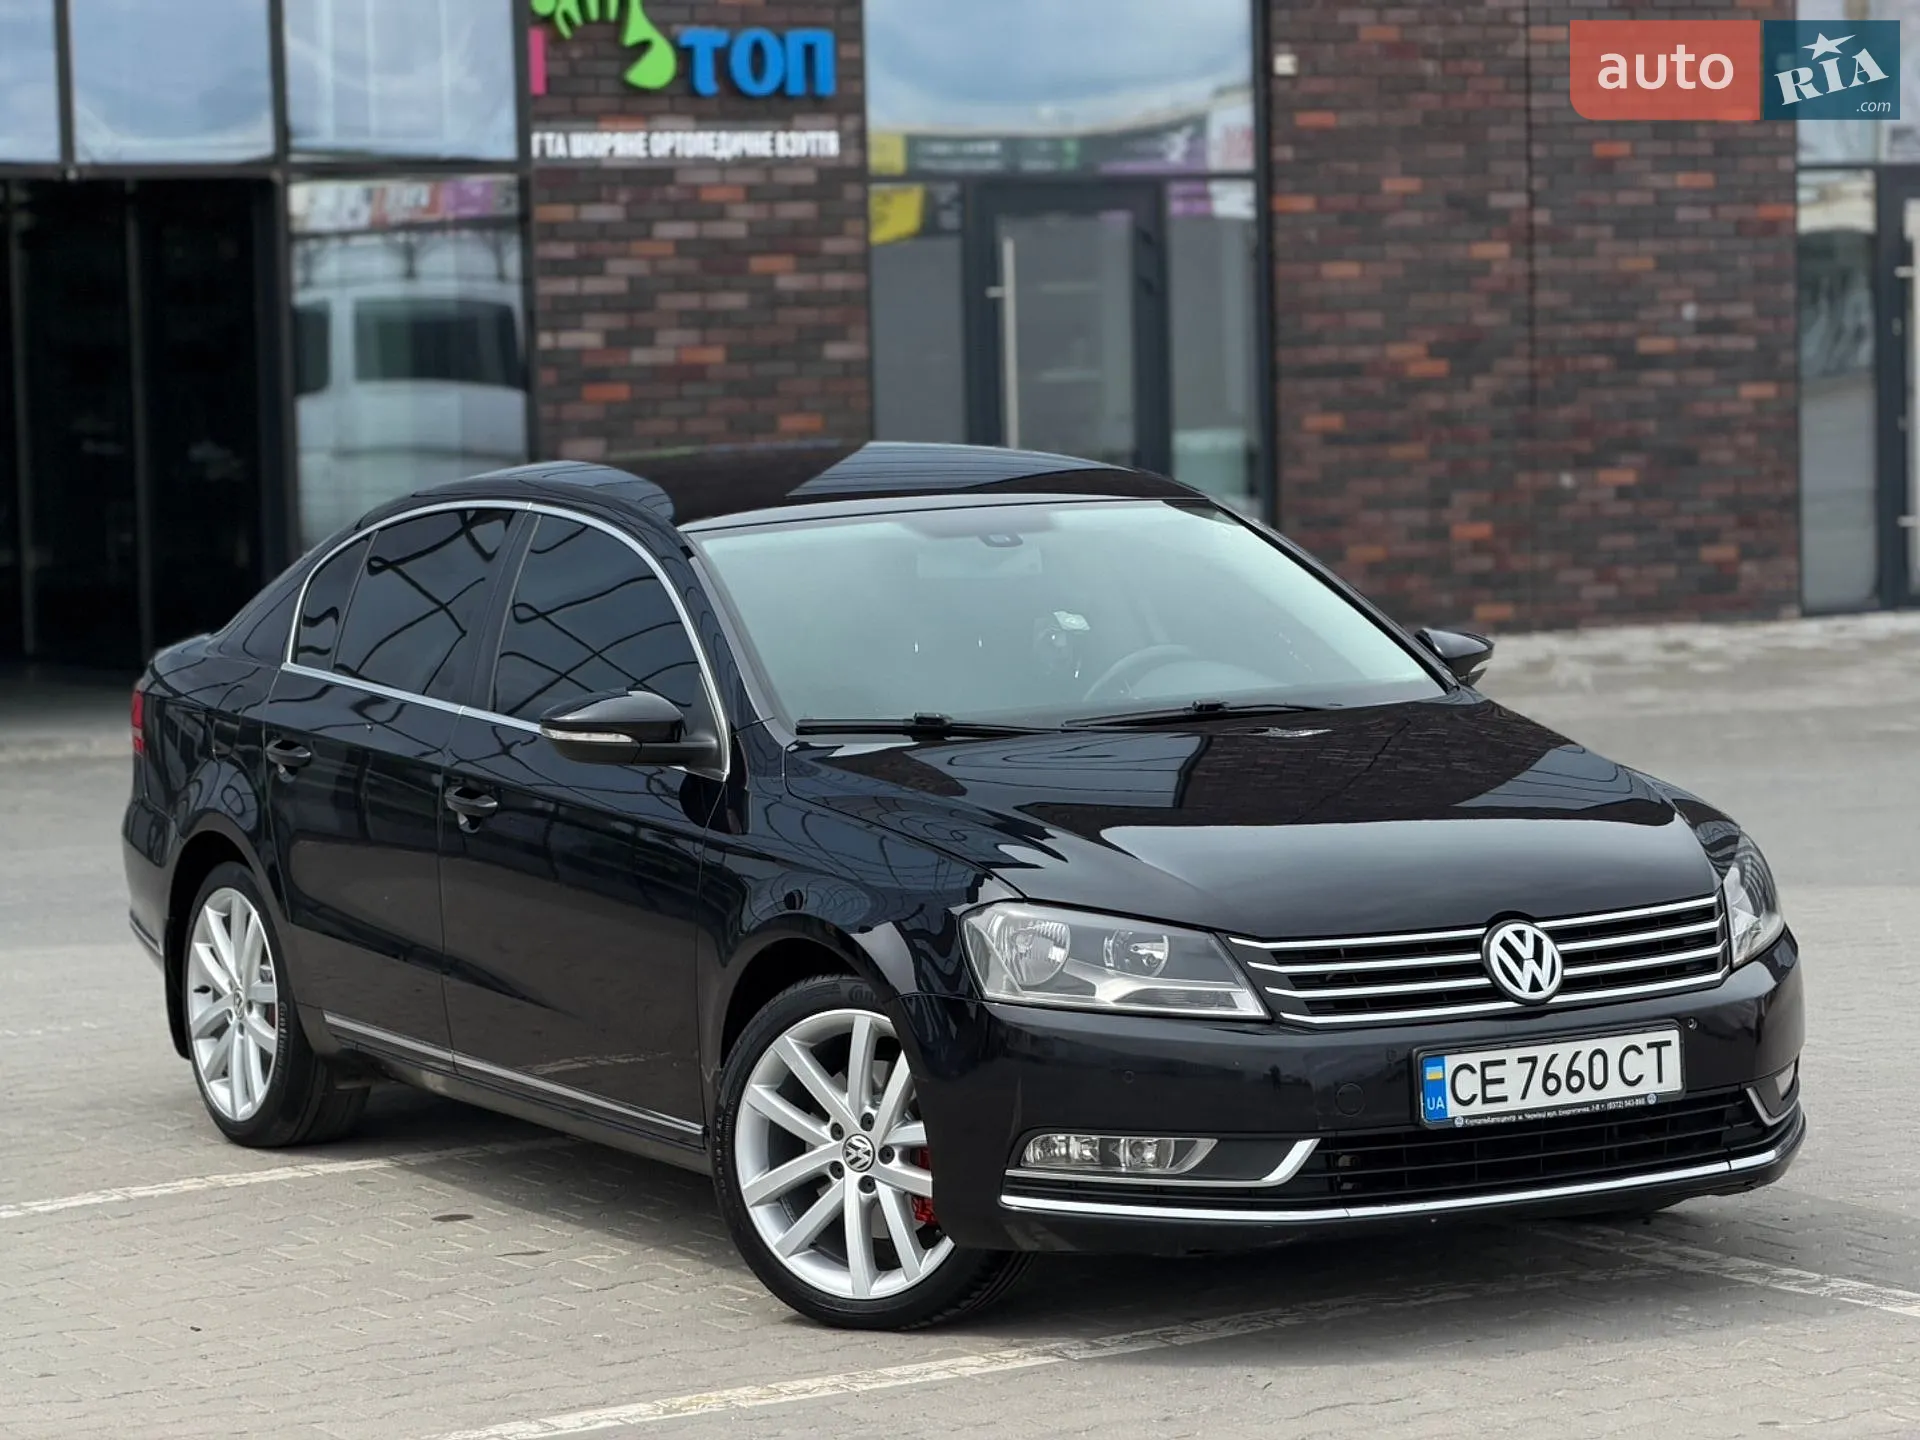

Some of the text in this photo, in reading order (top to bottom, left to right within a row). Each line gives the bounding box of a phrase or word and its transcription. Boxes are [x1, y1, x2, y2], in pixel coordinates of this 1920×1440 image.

[650, 130, 773, 161] ОРТОПЕДИЧНЕ
[775, 130, 839, 158] ВЗУТТЯ
[1449, 1039, 1672, 1106] CE 7660 CT
[1427, 1095, 1445, 1111] UA
